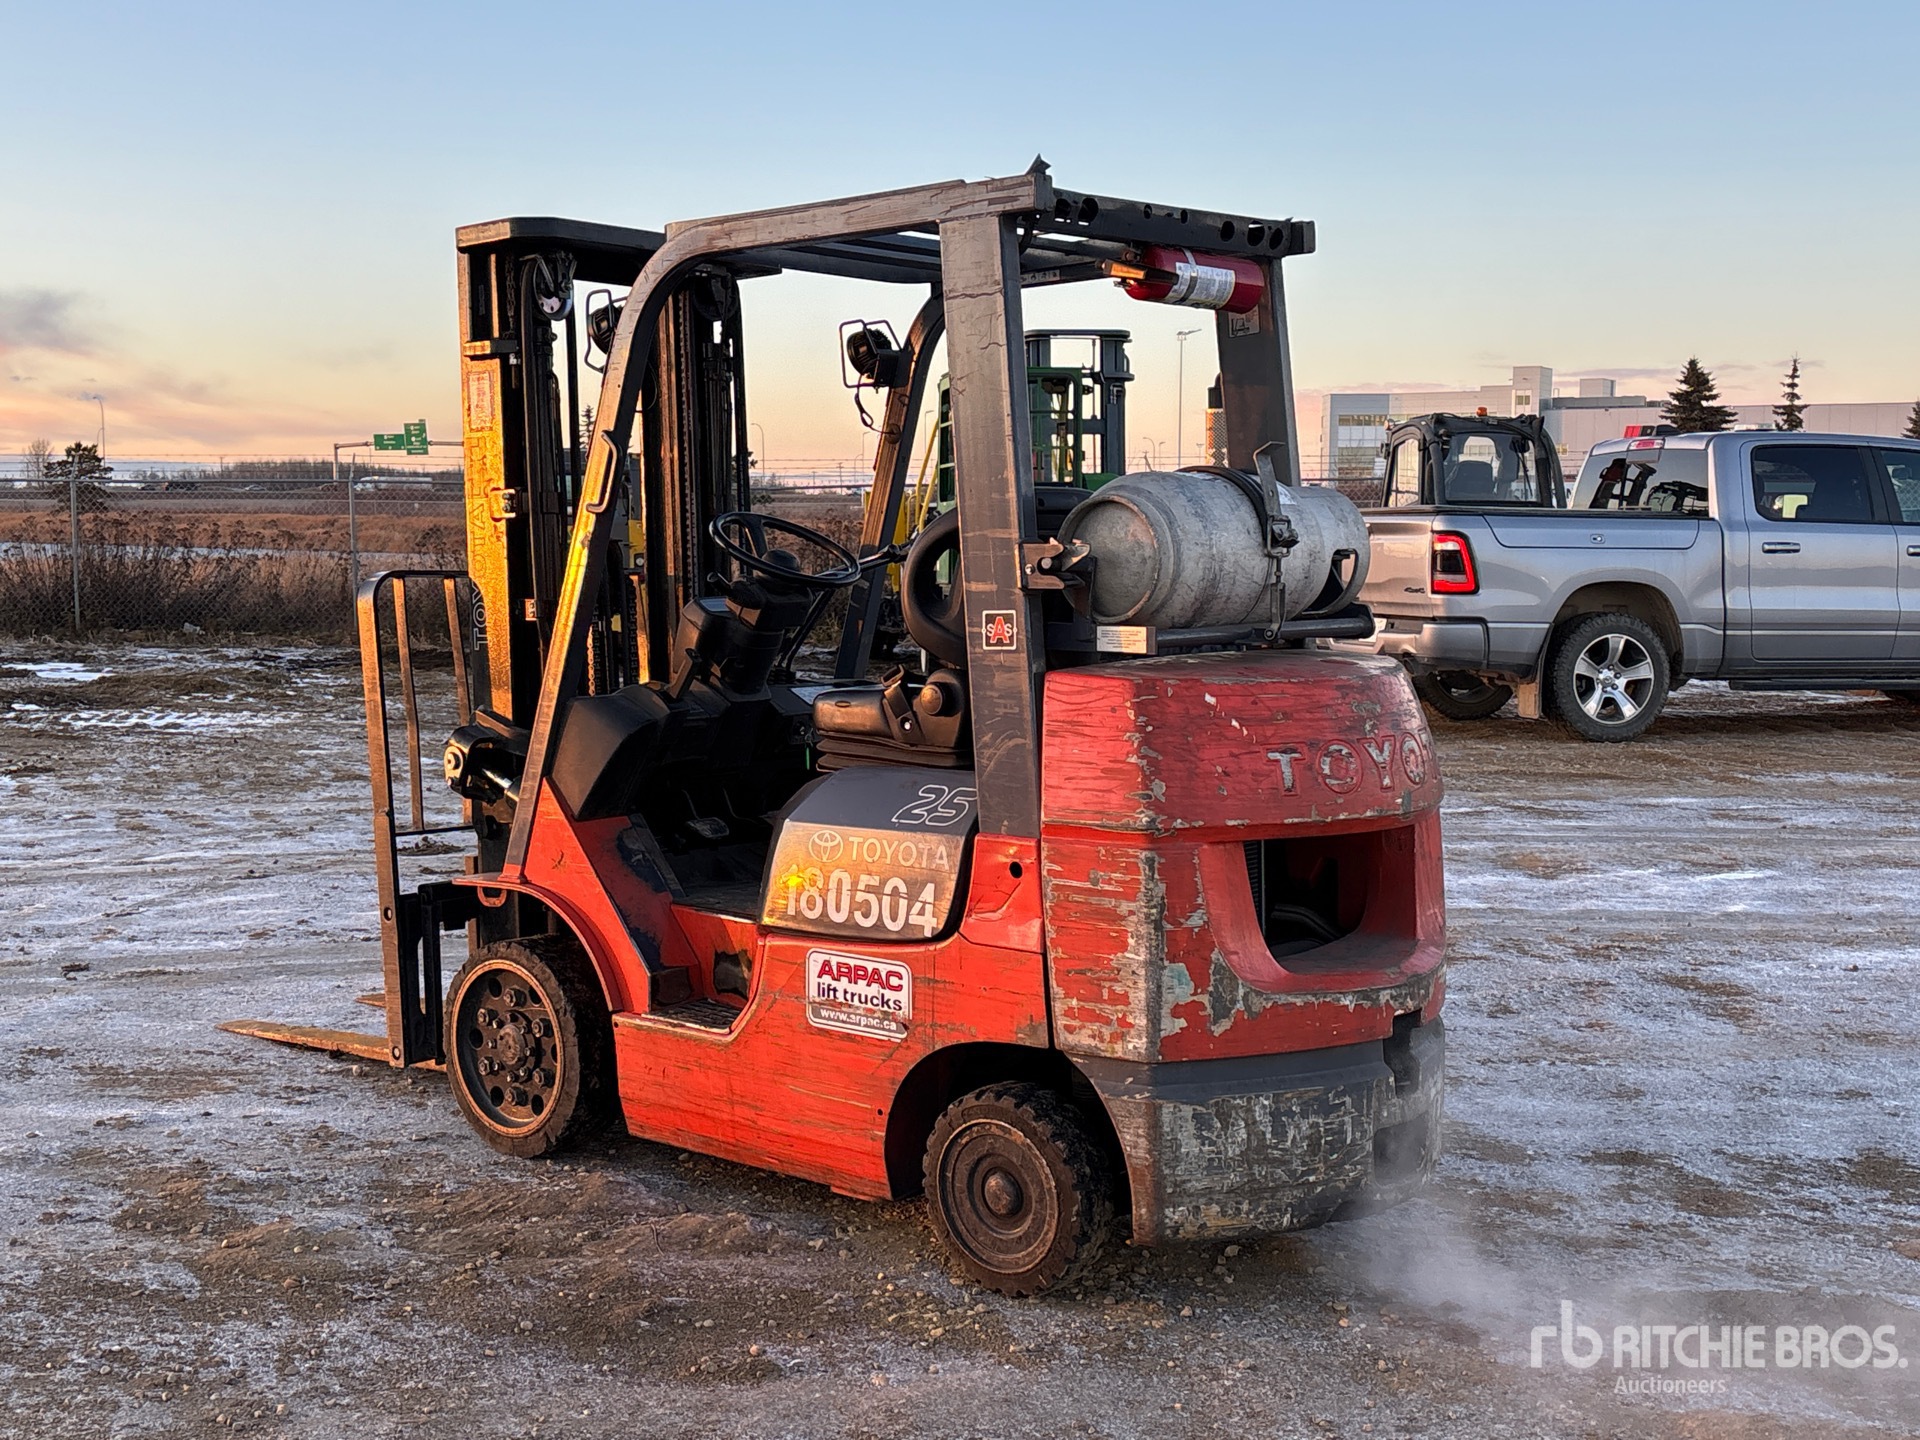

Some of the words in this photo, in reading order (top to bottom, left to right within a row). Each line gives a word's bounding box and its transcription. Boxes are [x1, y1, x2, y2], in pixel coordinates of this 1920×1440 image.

[891, 785, 977, 826] 25
[848, 836, 949, 870] TOYOTA
[780, 863, 938, 938] 180504
[817, 960, 903, 992] ARPAC
[817, 982, 839, 1000] lift
[843, 988, 902, 1011] trucks
